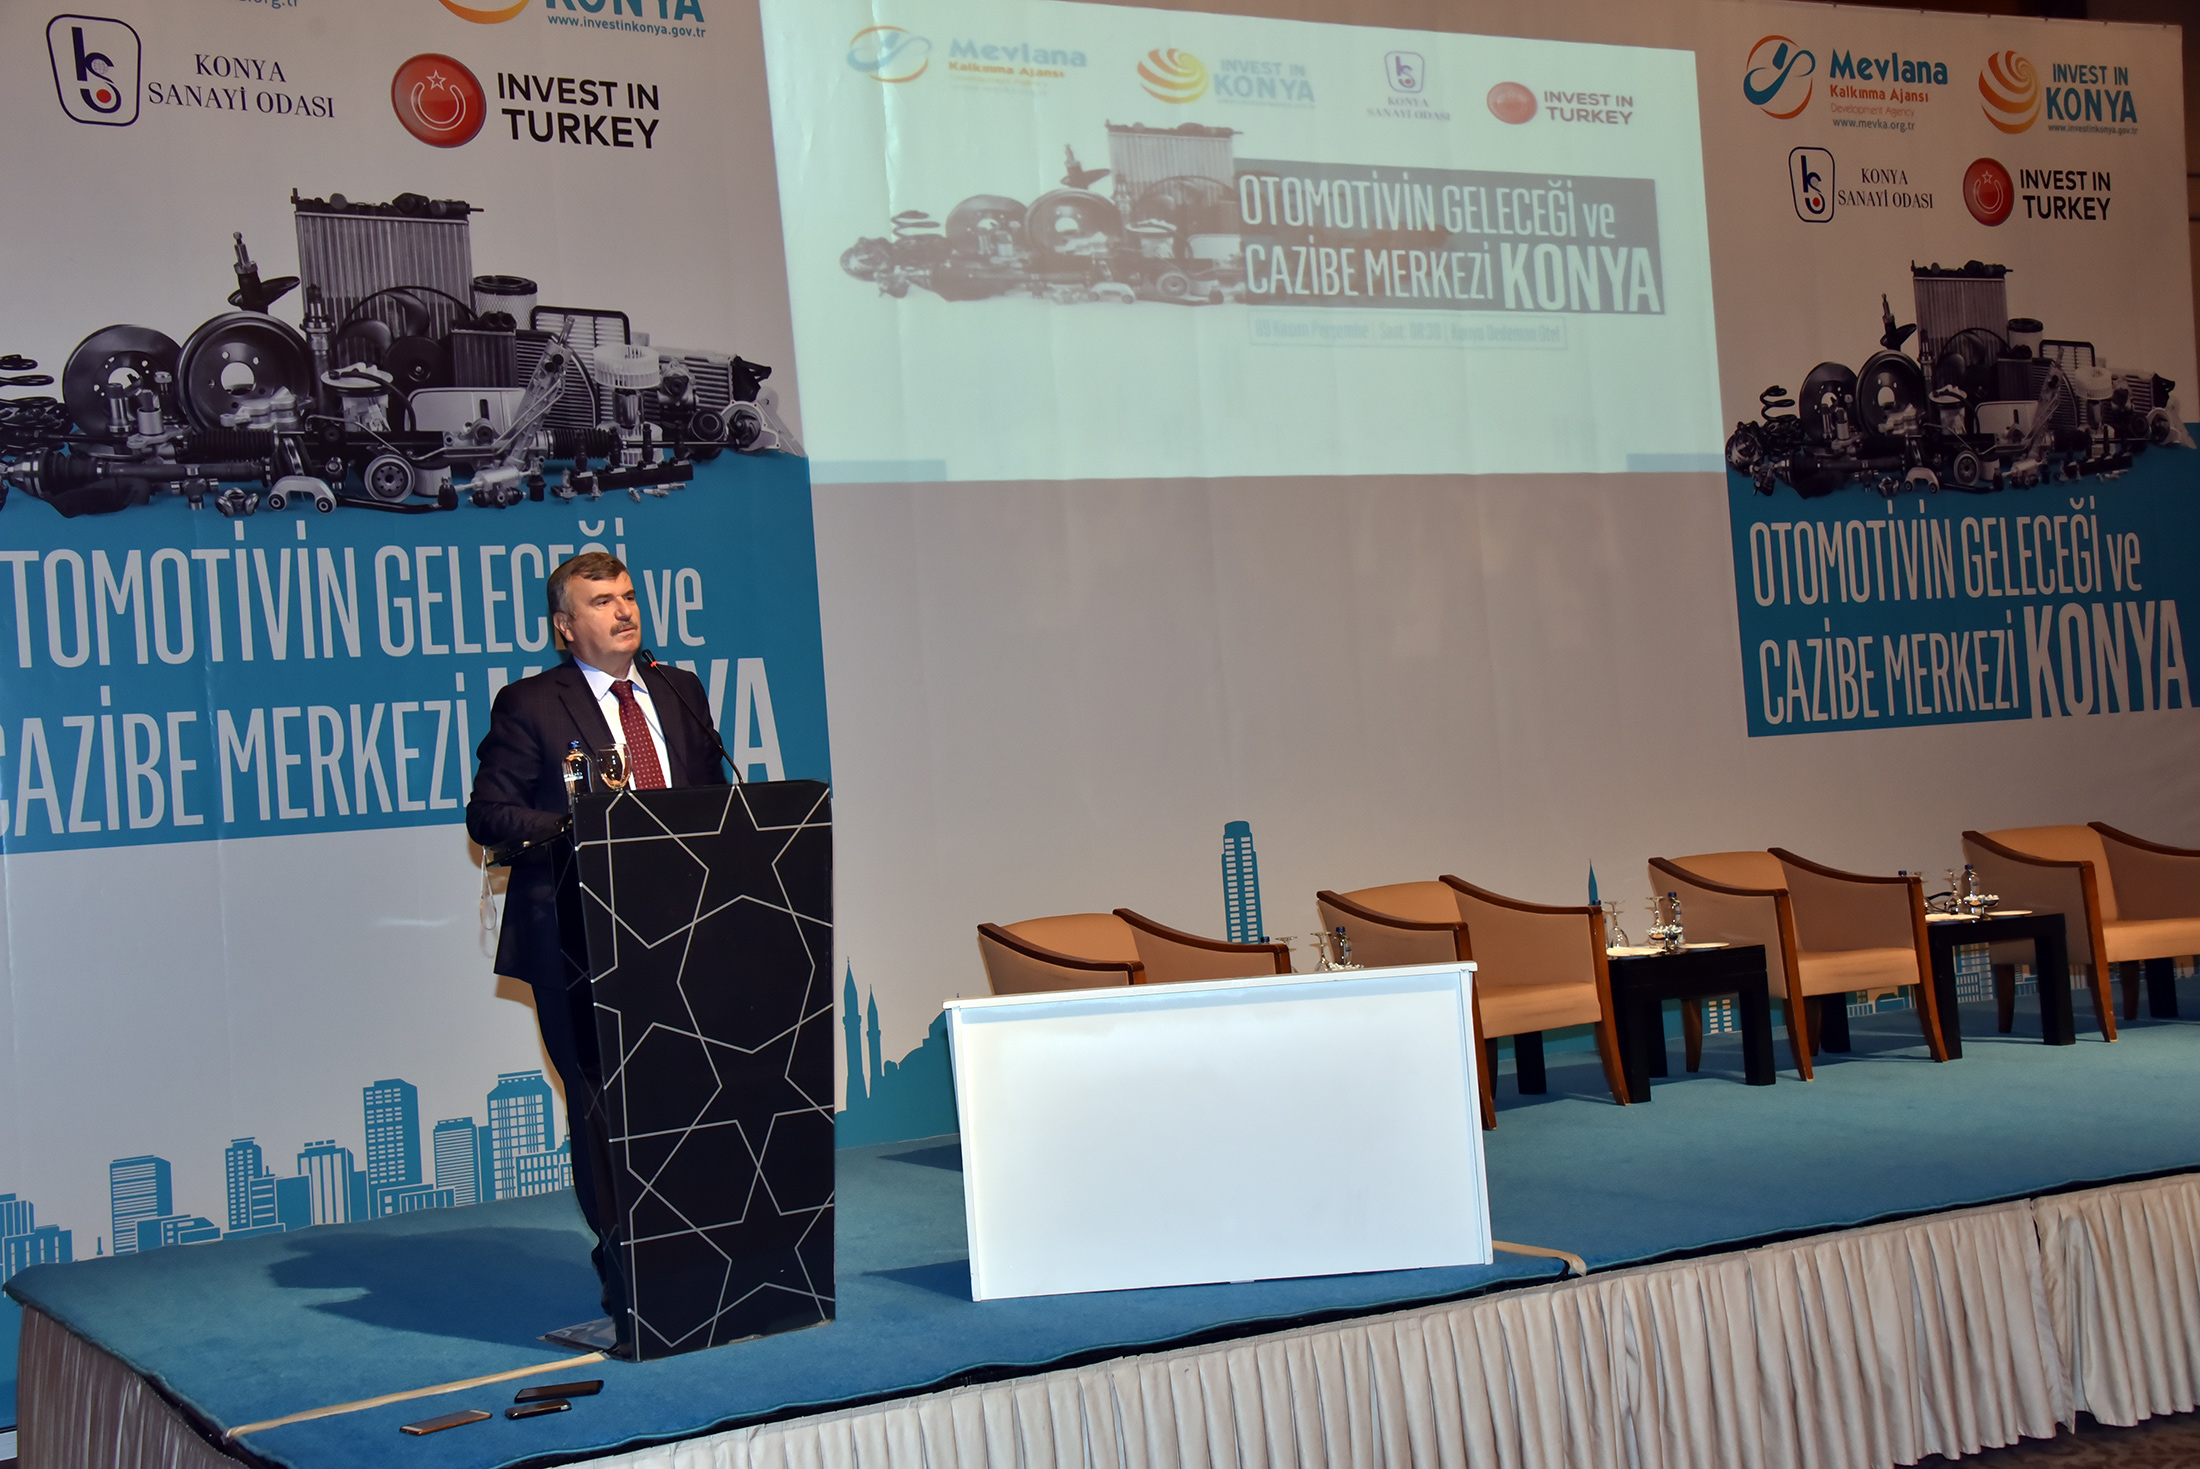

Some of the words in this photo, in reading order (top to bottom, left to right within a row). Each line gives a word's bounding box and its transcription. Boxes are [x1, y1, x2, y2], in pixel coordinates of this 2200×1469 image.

[548, 14, 706, 38] www.investinkonya.gov.tr
[949, 37, 1087, 67] Mevlana
[195, 53, 286, 84] KONYA
[1220, 58, 1282, 75] INVEST
[1289, 63, 1306, 77] IN
[1829, 48, 1948, 85] Mevlana
[2053, 63, 2107, 84] INVEST
[2114, 66, 2128, 86] IN
[148, 81, 250, 113] SANAYİ
[256, 92, 335, 119] ODASI
[498, 72, 618, 108] INVEST
[627, 83, 660, 111] IN
[1213, 73, 1315, 103] KONYA
[1387, 96, 1430, 108] KONYA
[1544, 90, 1610, 107] INVEST
[1616, 95, 1634, 108] IN
[1830, 84, 1886, 100] Kalkınma
[1890, 88, 1928, 104] Ajansı
[1545, 106, 1633, 125] TURKEY
[1831, 103, 1883, 116] Development
[1885, 105, 1914, 118] Agency
[2046, 87, 2137, 123] KONYA
[502, 108, 660, 149] TURKEY
[1833, 118, 1915, 133] www.mevka.org.tr
[2048, 124, 2138, 136] www.investinkonya.gov.tr
[1861, 167, 1908, 186] KONYA
[2019, 169, 2088, 192] INVEST
[2092, 171, 2111, 192] IN
[1239, 170, 1435, 232] OTOMOTİVİN
[1442, 179, 1577, 237] GELECEĞİ
[1582, 203, 1616, 239] ve
[1837, 188, 1889, 208] SANAYİ
[1892, 191, 1933, 209] ODASI
[2022, 195, 2111, 221] TURKEY
[1245, 234, 1360, 296] CAZİBE
[1364, 241, 1494, 300] MERKEZİ
[1500, 242, 1661, 312] KONYA
[1749, 499, 1956, 606] OTOMOTİVİN
[1960, 495, 2102, 598] GELECEĞİ
[2106, 532, 2142, 592] ve
[374, 517, 627, 657] GELEC
[643, 567, 706, 647] ve
[1759, 617, 1879, 725] CAZİBE
[1883, 609, 2019, 716] MERKEZİ
[2023, 599, 2192, 719] KONYA
[0, 685, 204, 837] AZİBE
[217, 672, 472, 823] MERKEZİ
